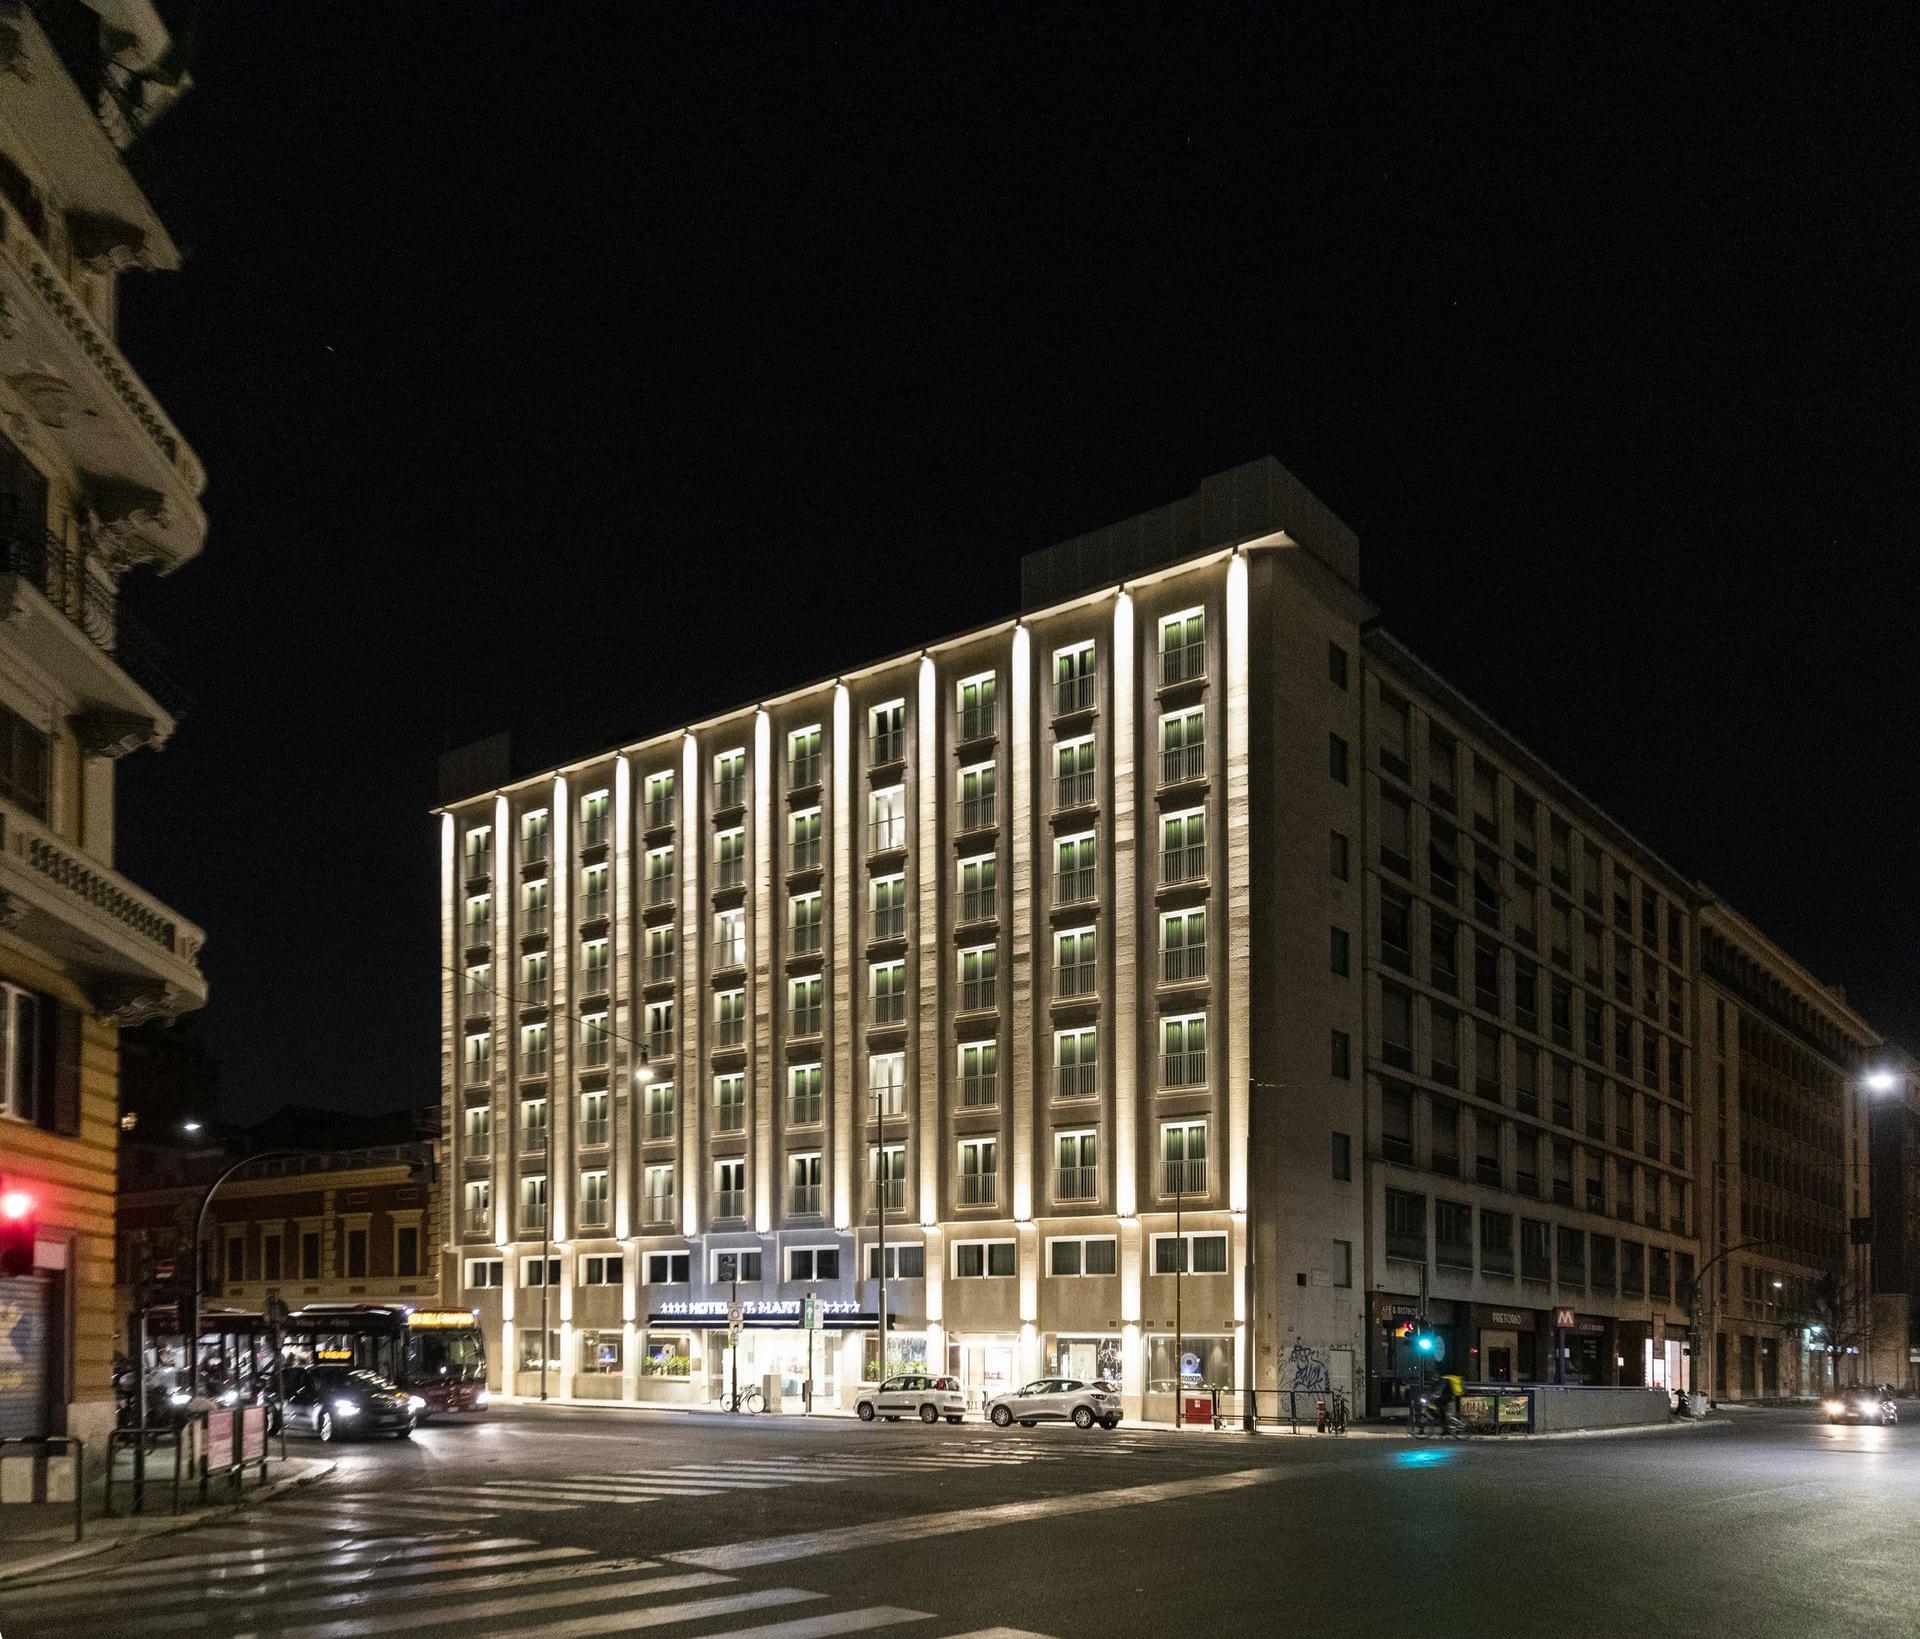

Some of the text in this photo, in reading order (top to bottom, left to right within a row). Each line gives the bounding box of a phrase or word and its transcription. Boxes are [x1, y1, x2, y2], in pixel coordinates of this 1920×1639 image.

[689, 1301, 729, 1315] HOTEL
[1492, 1312, 1522, 1325] PRETORIO
[1557, 1310, 1573, 1324] M
